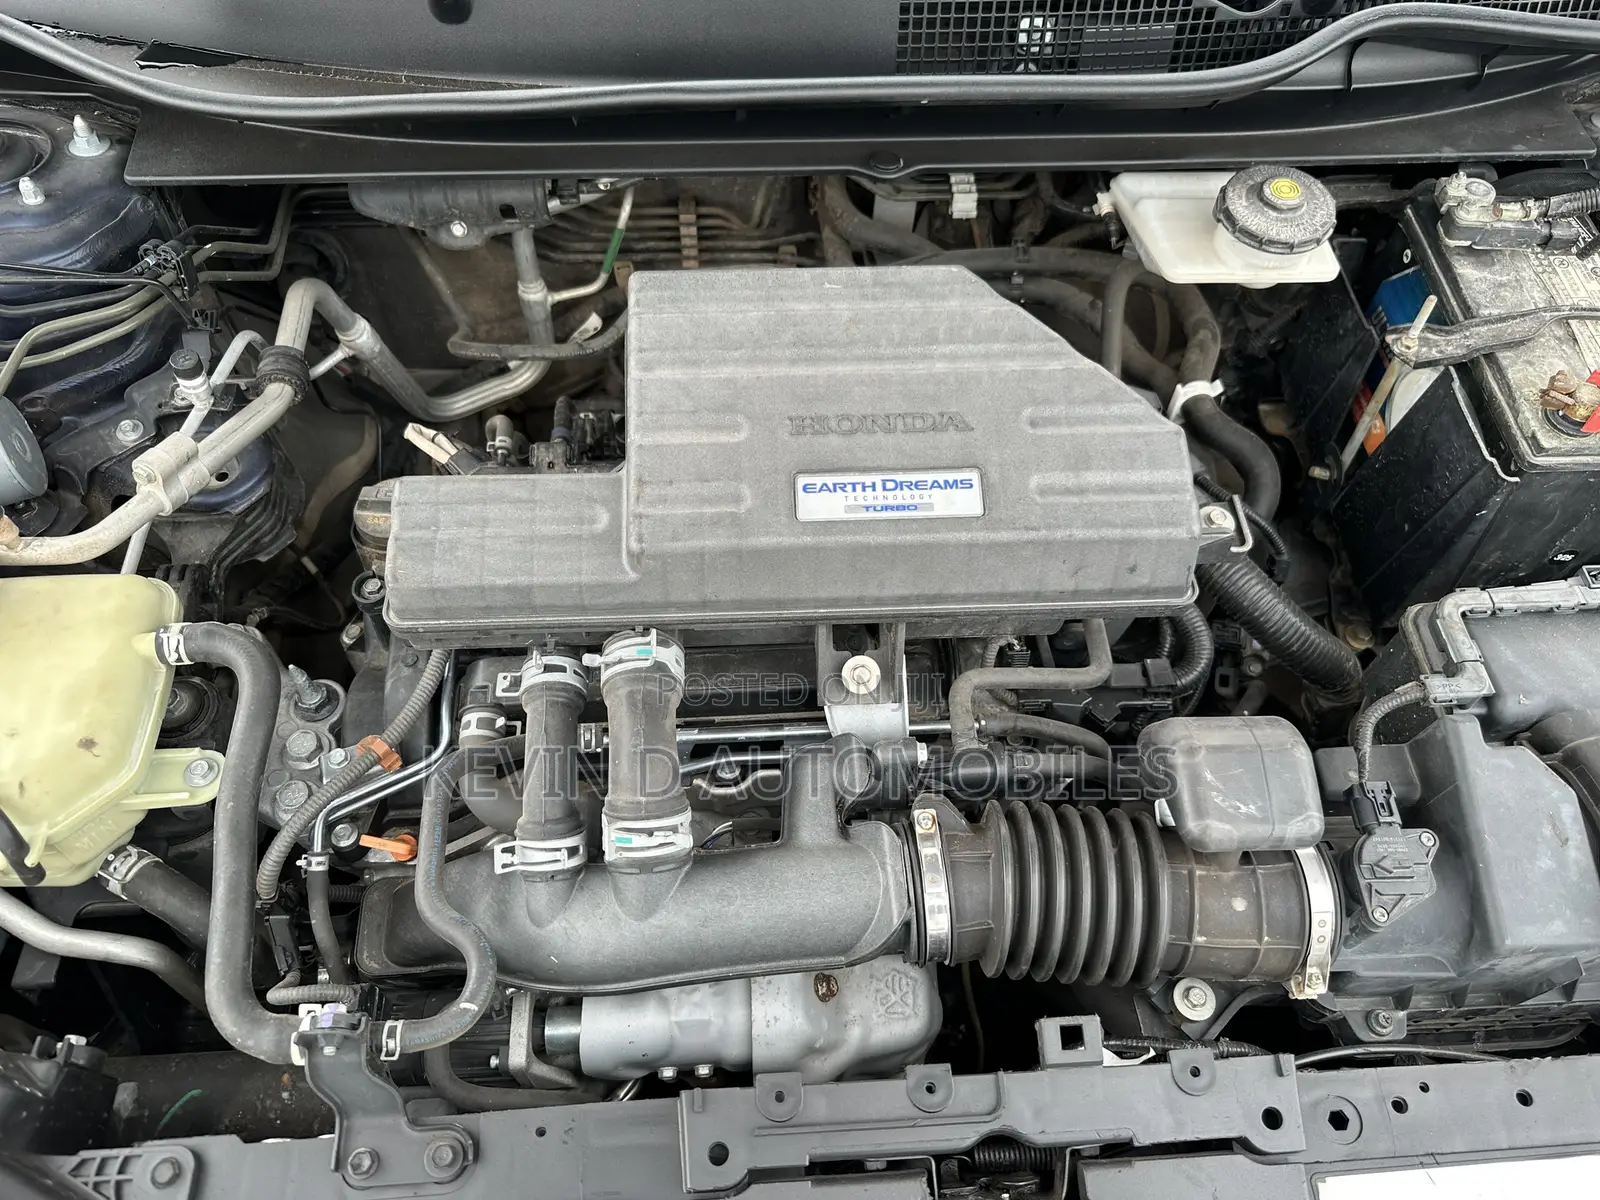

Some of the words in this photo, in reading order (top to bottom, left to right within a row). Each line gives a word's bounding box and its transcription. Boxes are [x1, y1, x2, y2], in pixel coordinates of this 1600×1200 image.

[787, 410, 975, 436] HONDA
[802, 480, 877, 494] EARTH
[881, 478, 974, 493] DREAMS
[844, 493, 934, 502] TECHNOLOGY
[863, 504, 919, 513] TURBO
[76, 820, 119, 851] MIN
